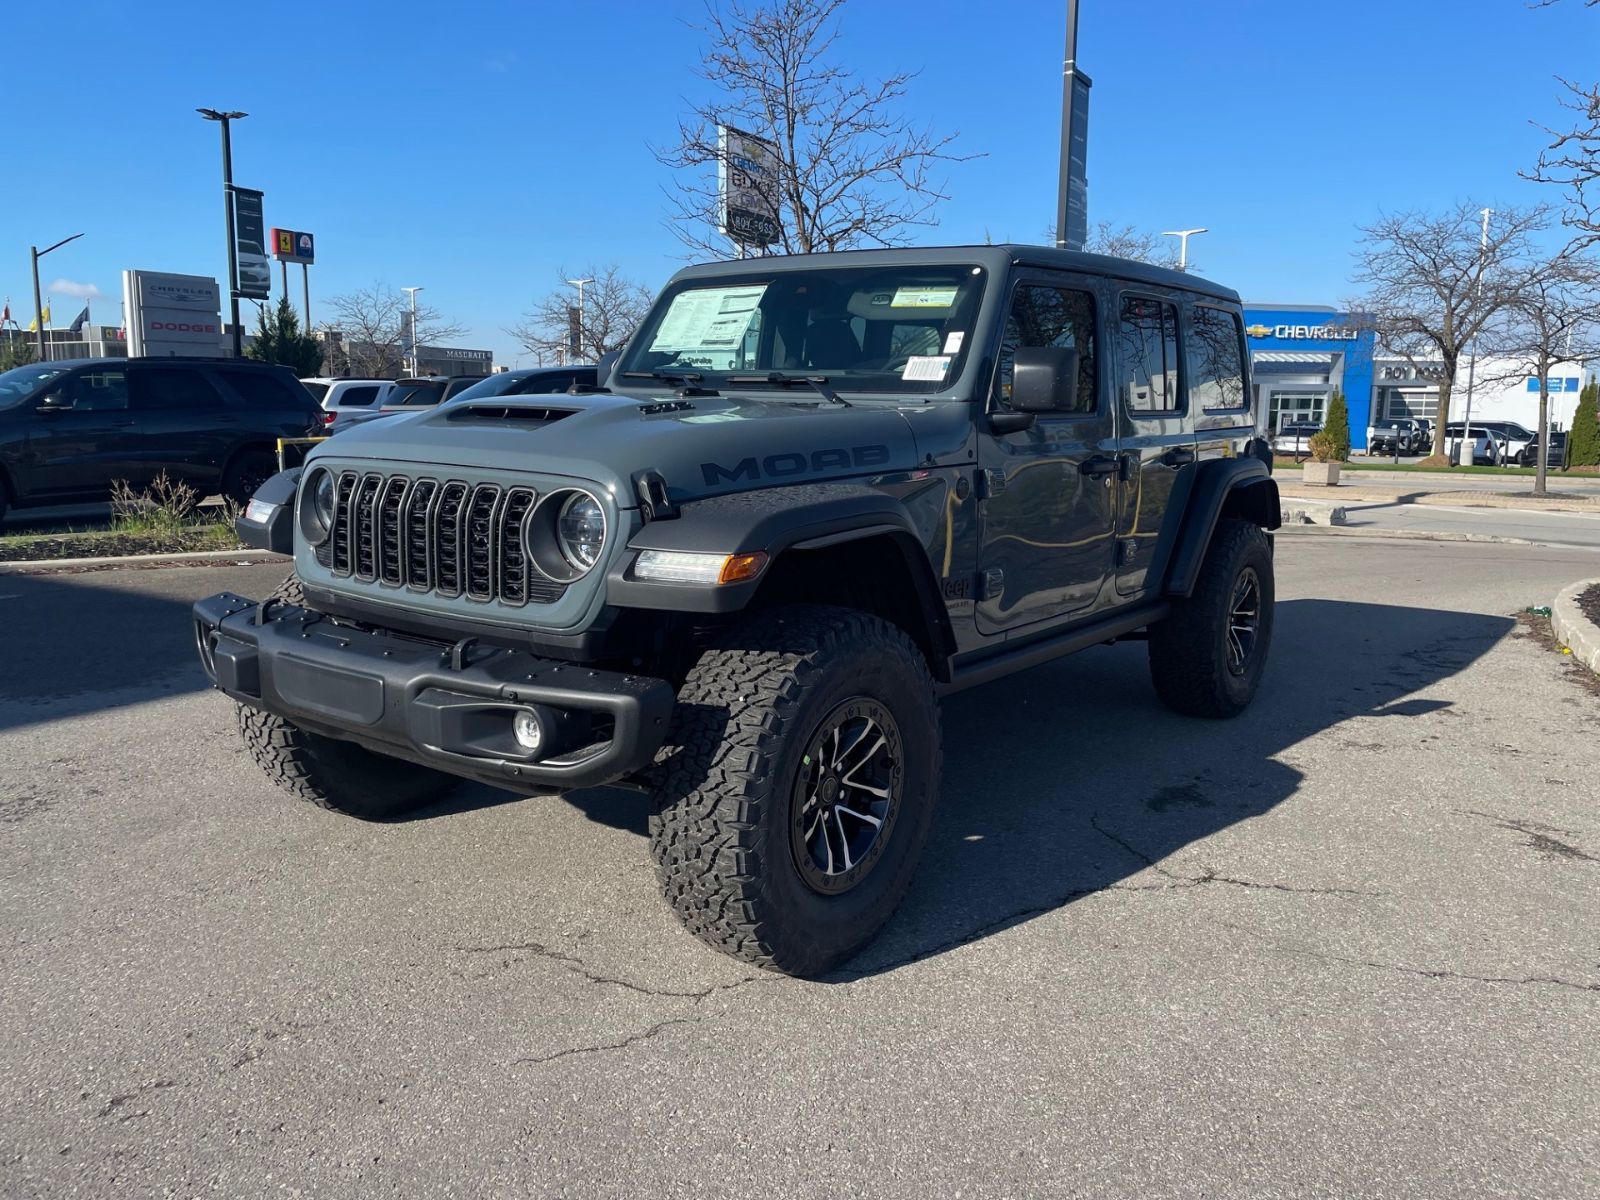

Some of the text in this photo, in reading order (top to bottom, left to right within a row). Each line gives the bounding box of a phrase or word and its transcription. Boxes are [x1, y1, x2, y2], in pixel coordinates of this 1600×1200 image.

[150, 285, 212, 295] CHRYSLER
[151, 322, 216, 333] DODGE
[1275, 325, 1358, 340] CHEVROLET
[446, 350, 486, 359] MASERATI
[1384, 367, 1407, 380] ROY
[700, 444, 890, 487] MOAB
